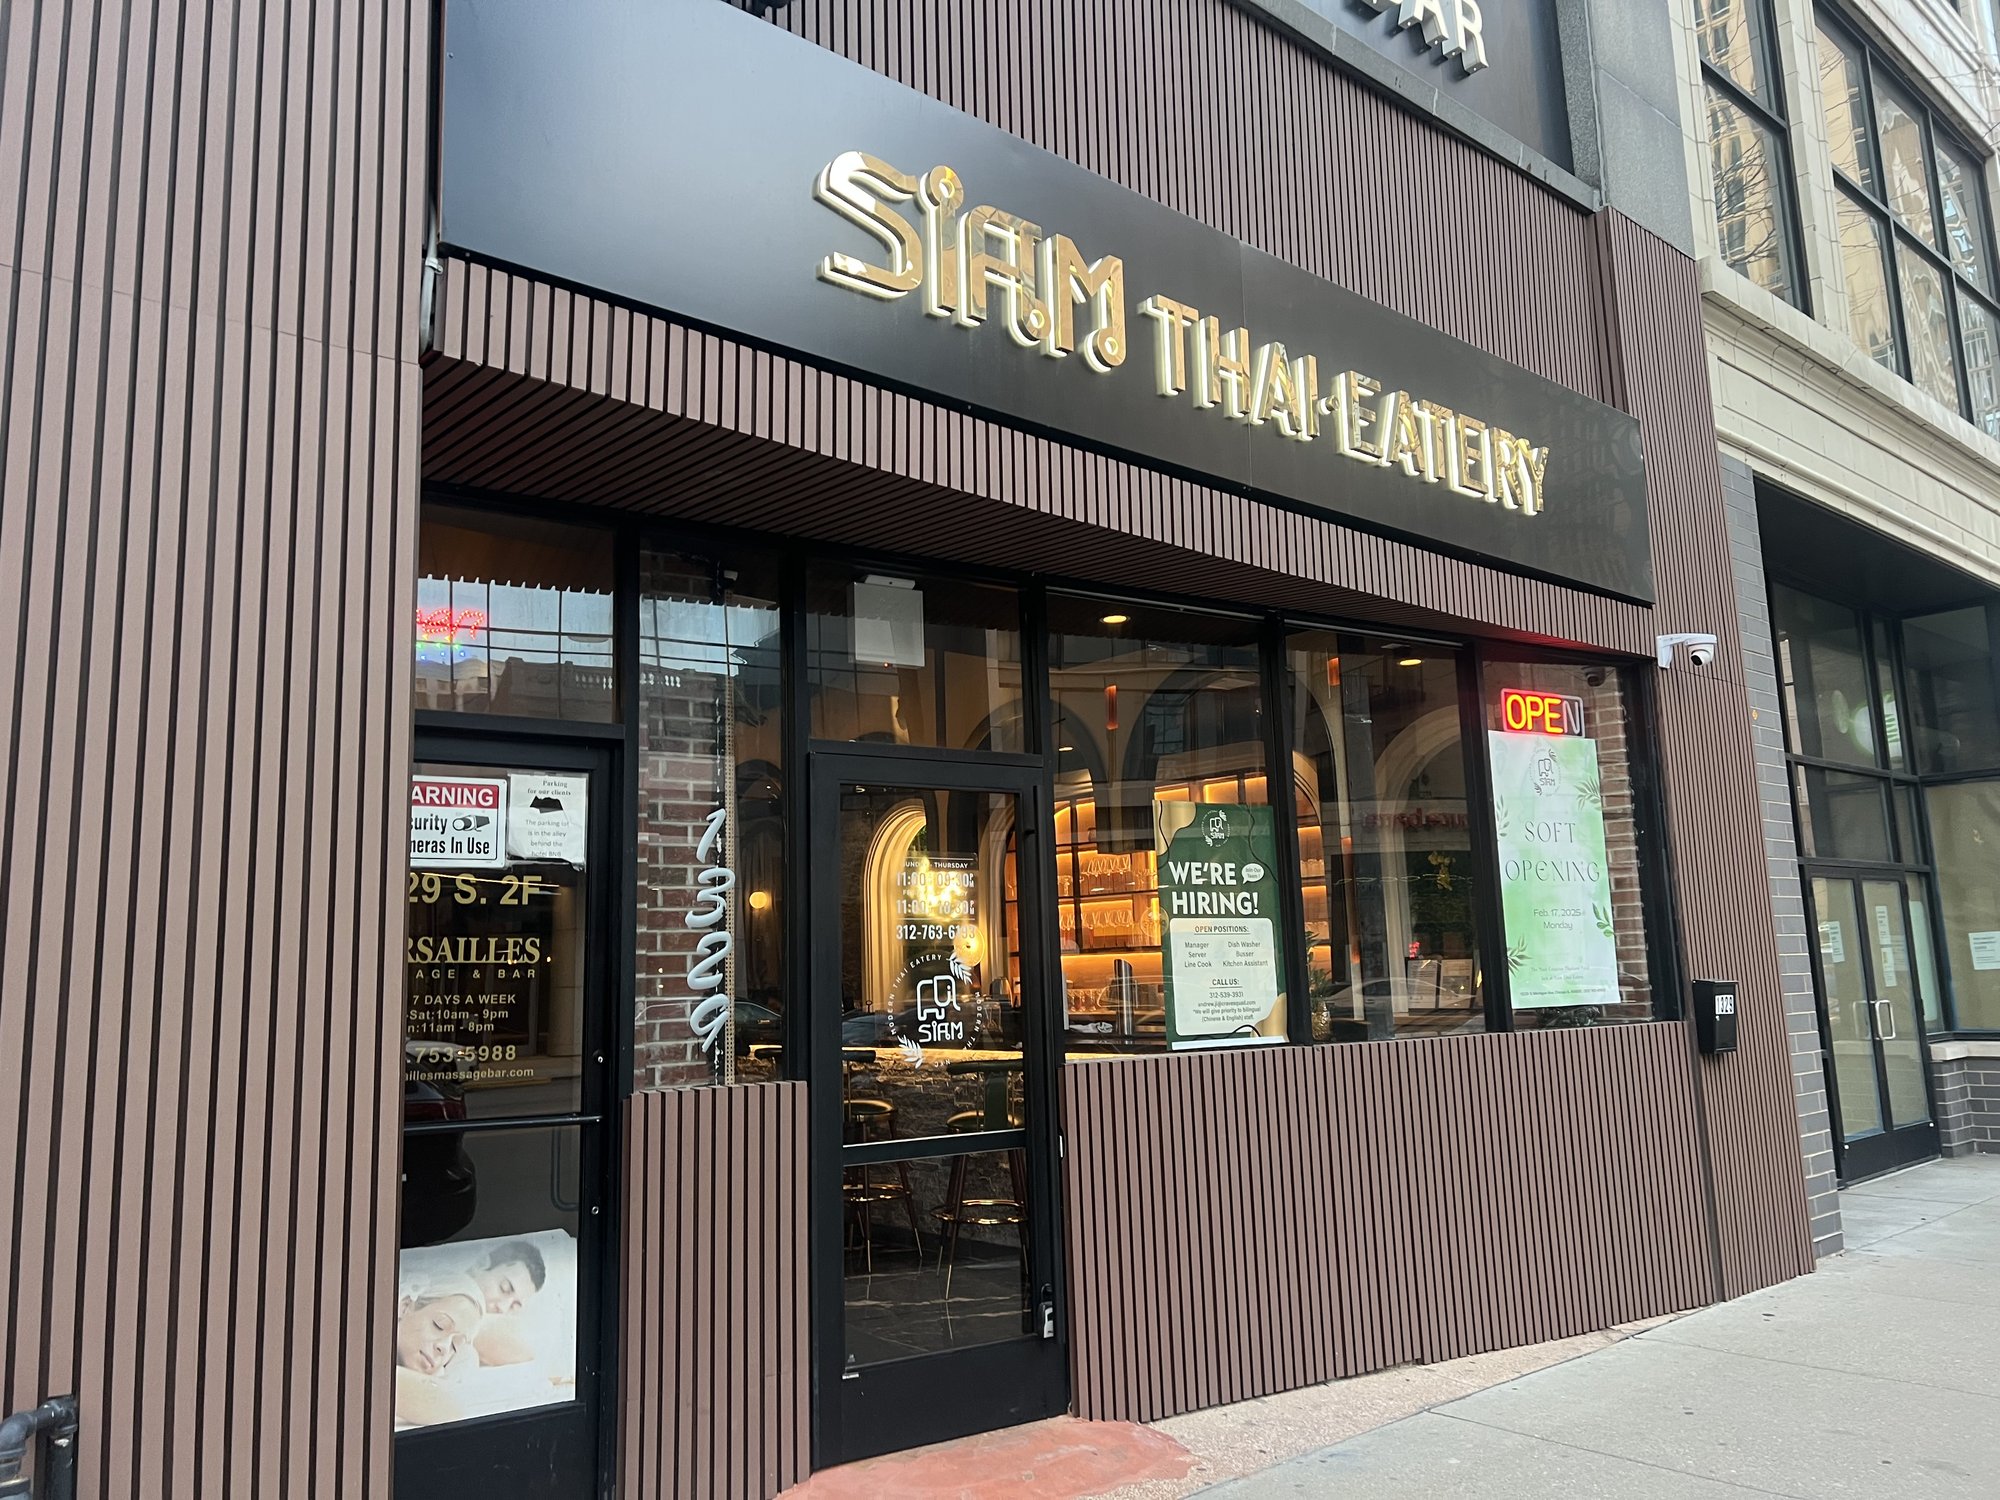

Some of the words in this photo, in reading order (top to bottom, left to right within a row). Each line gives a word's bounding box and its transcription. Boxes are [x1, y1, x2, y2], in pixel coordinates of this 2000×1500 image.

[1362, 0, 1489, 75] AR
[1138, 293, 1320, 442] THAI
[1332, 369, 1550, 516] EATERY
[1506, 694, 1580, 735] OPEN
[542, 780, 568, 788] Parking
[412, 785, 494, 807] ARNING
[1524, 821, 1576, 843] SOFT
[451, 836, 463, 854] In
[467, 837, 490, 855] Use
[1505, 859, 1600, 882] OPENING
[409, 872, 441, 904] 29
[454, 873, 487, 905] S.
[500, 875, 543, 905] 2F
[1171, 891, 1259, 916] HIRING!
[1543, 920, 1573, 930] Monday
[408, 936, 541, 964] RSAILLES
[415, 969, 455, 980] AGE
[473, 969, 481, 980] &
[498, 969, 536, 980] BAR
[412, 995, 419, 1005] 7
[424, 994, 461, 1005] DAYS
[465, 994, 474, 1005] A
[478, 993, 516, 1005] WEEK
[406, 1009, 470, 1021] -Sat:10am
[482, 1009, 509, 1022] 9pm
[407, 1021, 455, 1033] n:11am
[468, 1021, 495, 1034] 8pm
[406, 1067, 535, 1082] illesmassagebar.com
